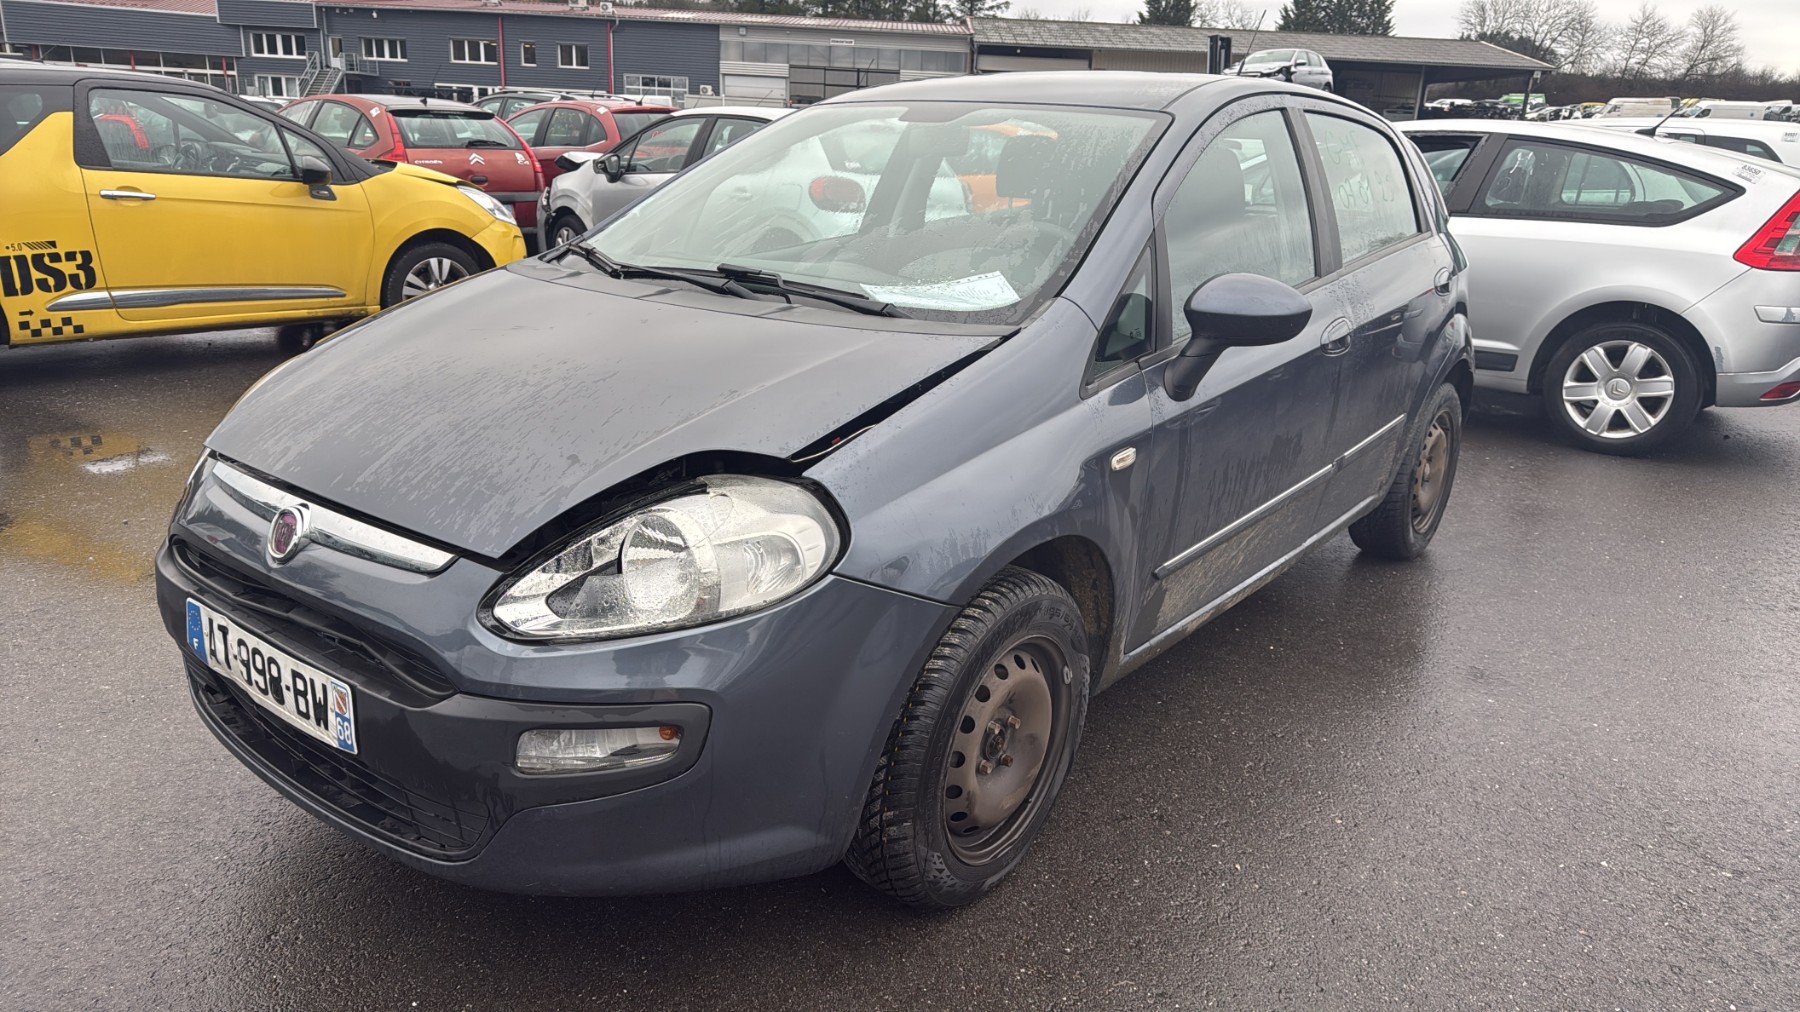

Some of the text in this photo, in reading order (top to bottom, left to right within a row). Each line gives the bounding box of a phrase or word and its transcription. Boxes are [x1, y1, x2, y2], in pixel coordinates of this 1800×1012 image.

[0, 250, 97, 297] DS3
[193, 638, 199, 649] F
[337, 716, 352, 745] 68
